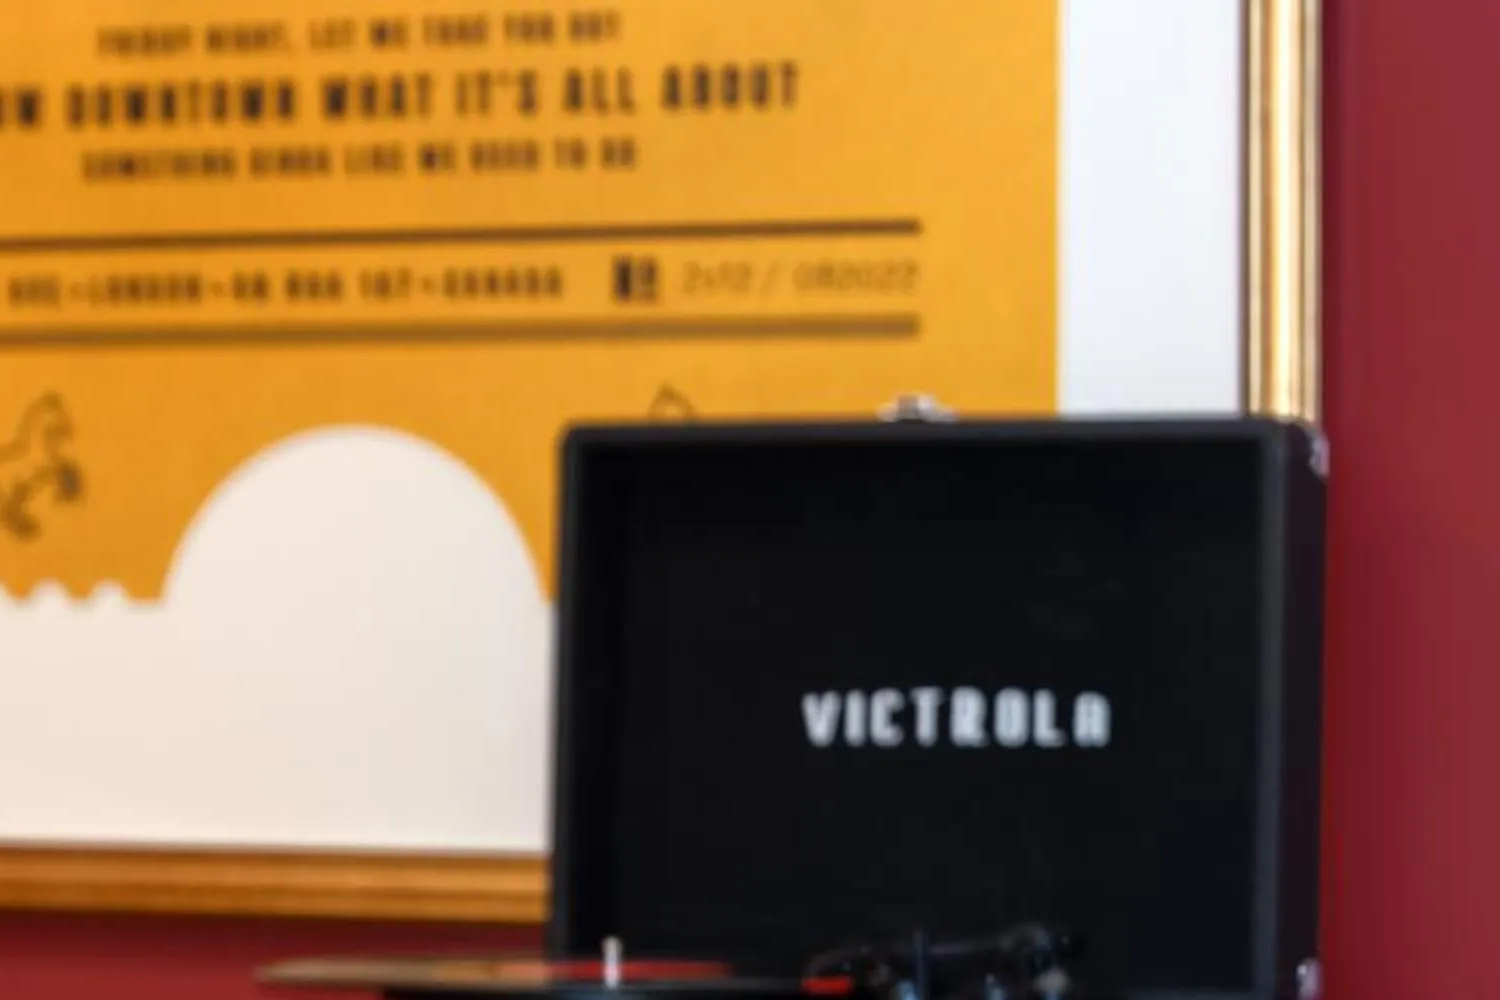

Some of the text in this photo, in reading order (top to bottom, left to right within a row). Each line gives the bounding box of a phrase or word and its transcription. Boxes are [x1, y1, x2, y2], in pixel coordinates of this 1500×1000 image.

[63, 80, 298, 128] DOWNTOWN
[319, 76, 434, 120] WHAT
[453, 70, 542, 117] IT'S
[560, 69, 637, 116] ALL
[660, 64, 798, 110] ABOUT
[802, 686, 1112, 748] VICTROLA
